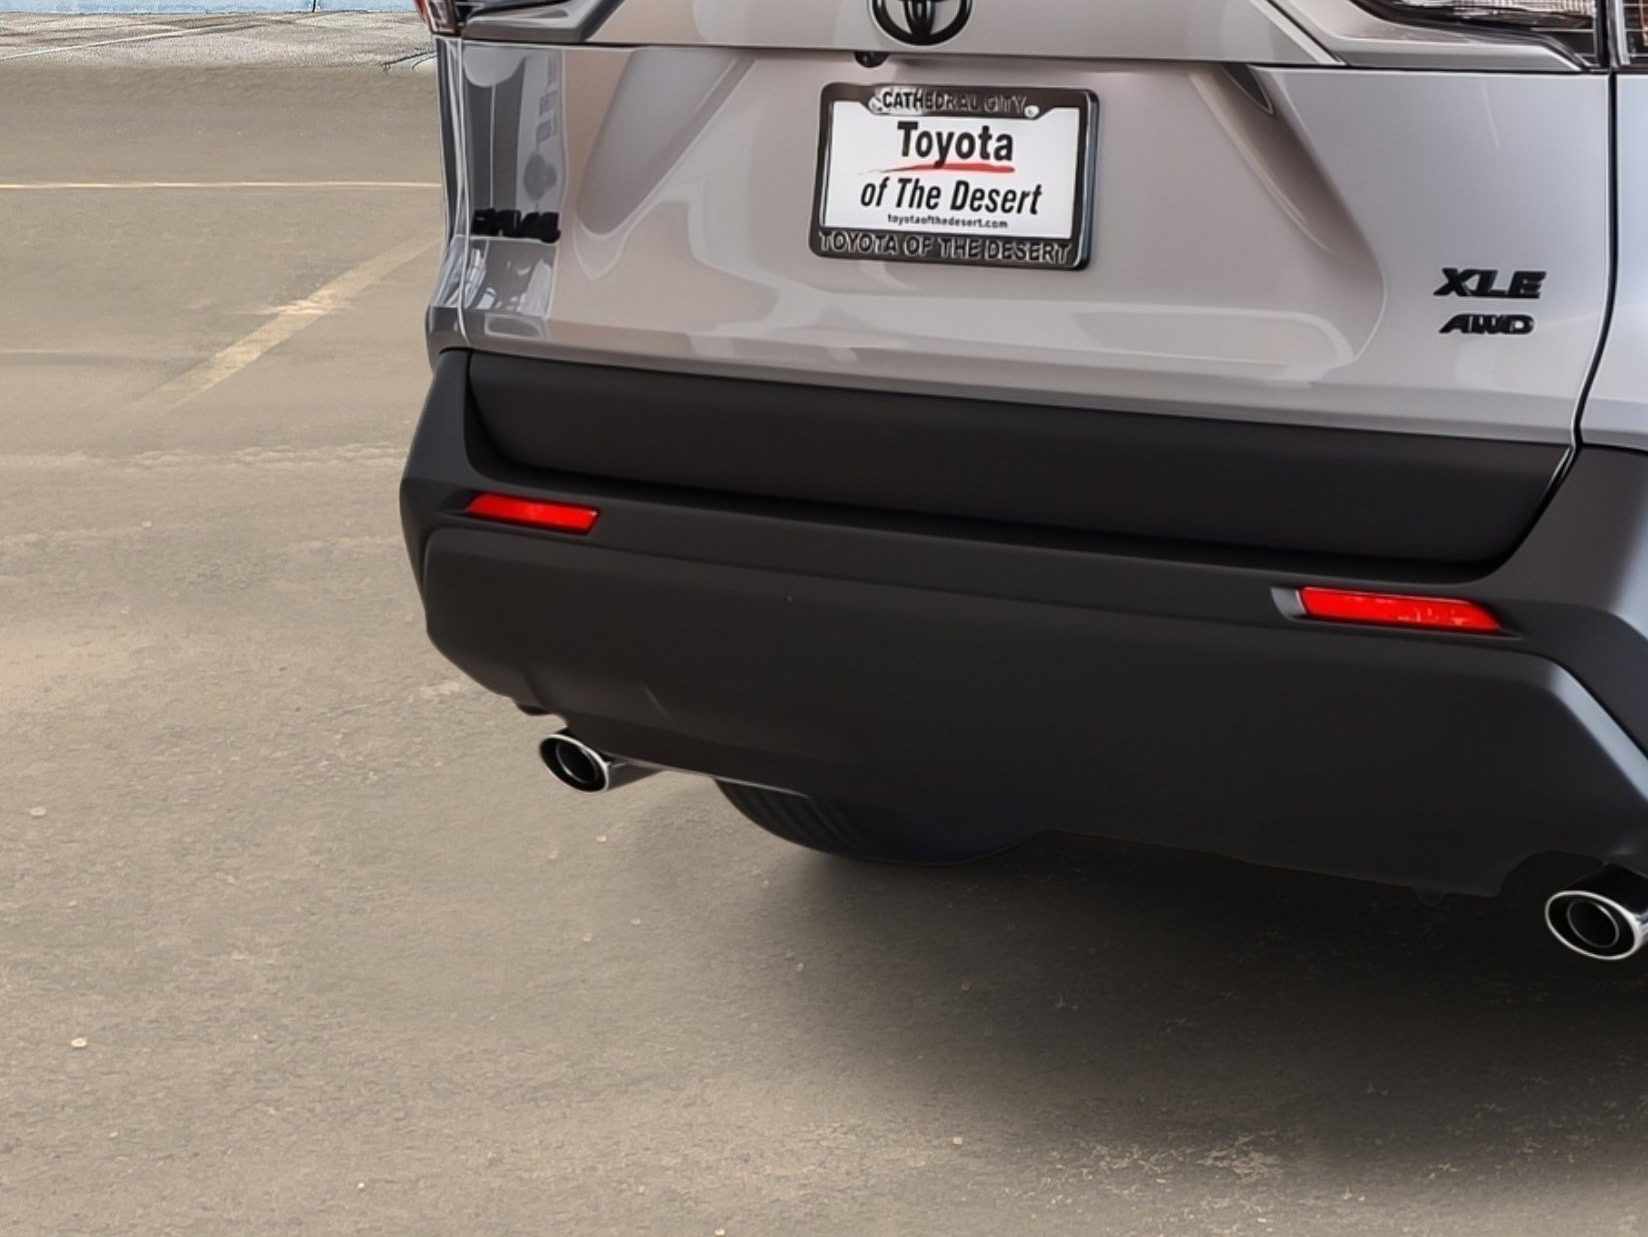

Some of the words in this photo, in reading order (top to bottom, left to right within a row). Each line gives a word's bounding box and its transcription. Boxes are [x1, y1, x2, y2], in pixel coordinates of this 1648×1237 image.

[882, 90, 977, 111] CATHEDRAL
[897, 121, 1013, 169] Toyota
[861, 177, 890, 207] of
[896, 178, 941, 210] The
[950, 180, 1042, 215] Desert
[888, 214, 1008, 229] toyotaofthedesert.com
[819, 231, 899, 256] TOYOTA
[903, 235, 933, 256] OF
[938, 237, 981, 259] THE
[985, 239, 1072, 265] DESERT
[1433, 267, 1547, 299] XLE
[1438, 314, 1534, 335] AWD
